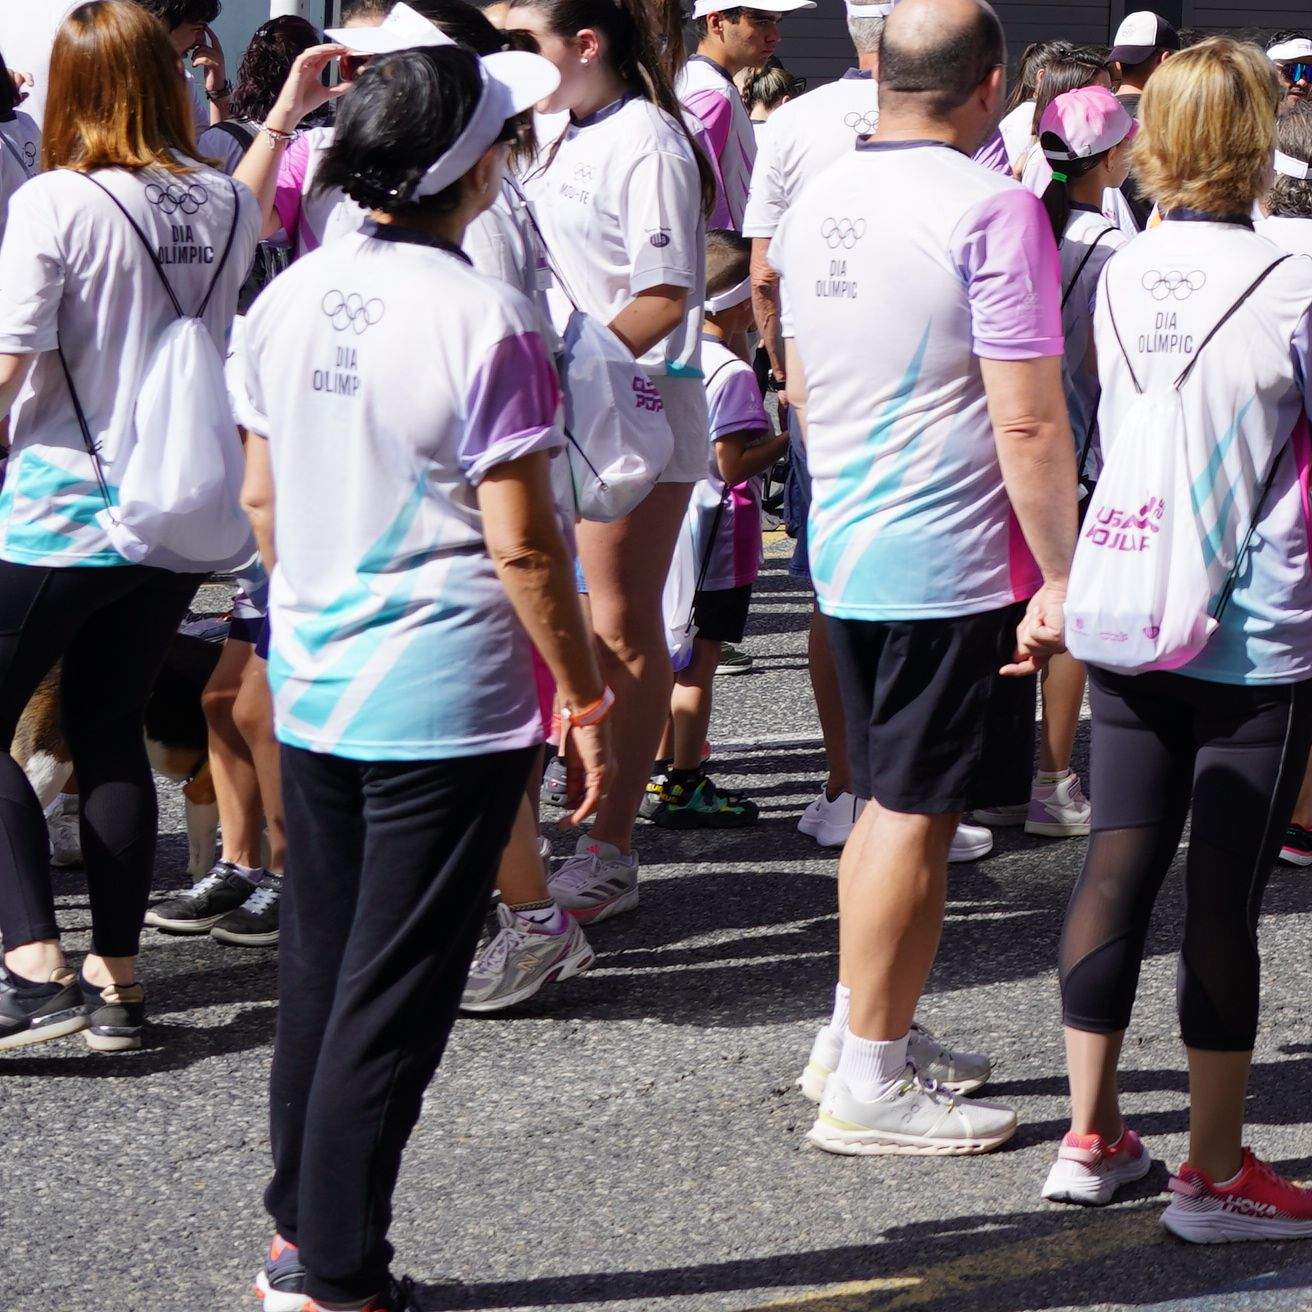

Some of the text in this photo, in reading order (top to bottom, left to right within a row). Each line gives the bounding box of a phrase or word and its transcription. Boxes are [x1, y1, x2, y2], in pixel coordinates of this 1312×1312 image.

[171, 224, 195, 243] DIA
[830, 259, 847, 277] DIA
[1155, 311, 1177, 330] DIA
